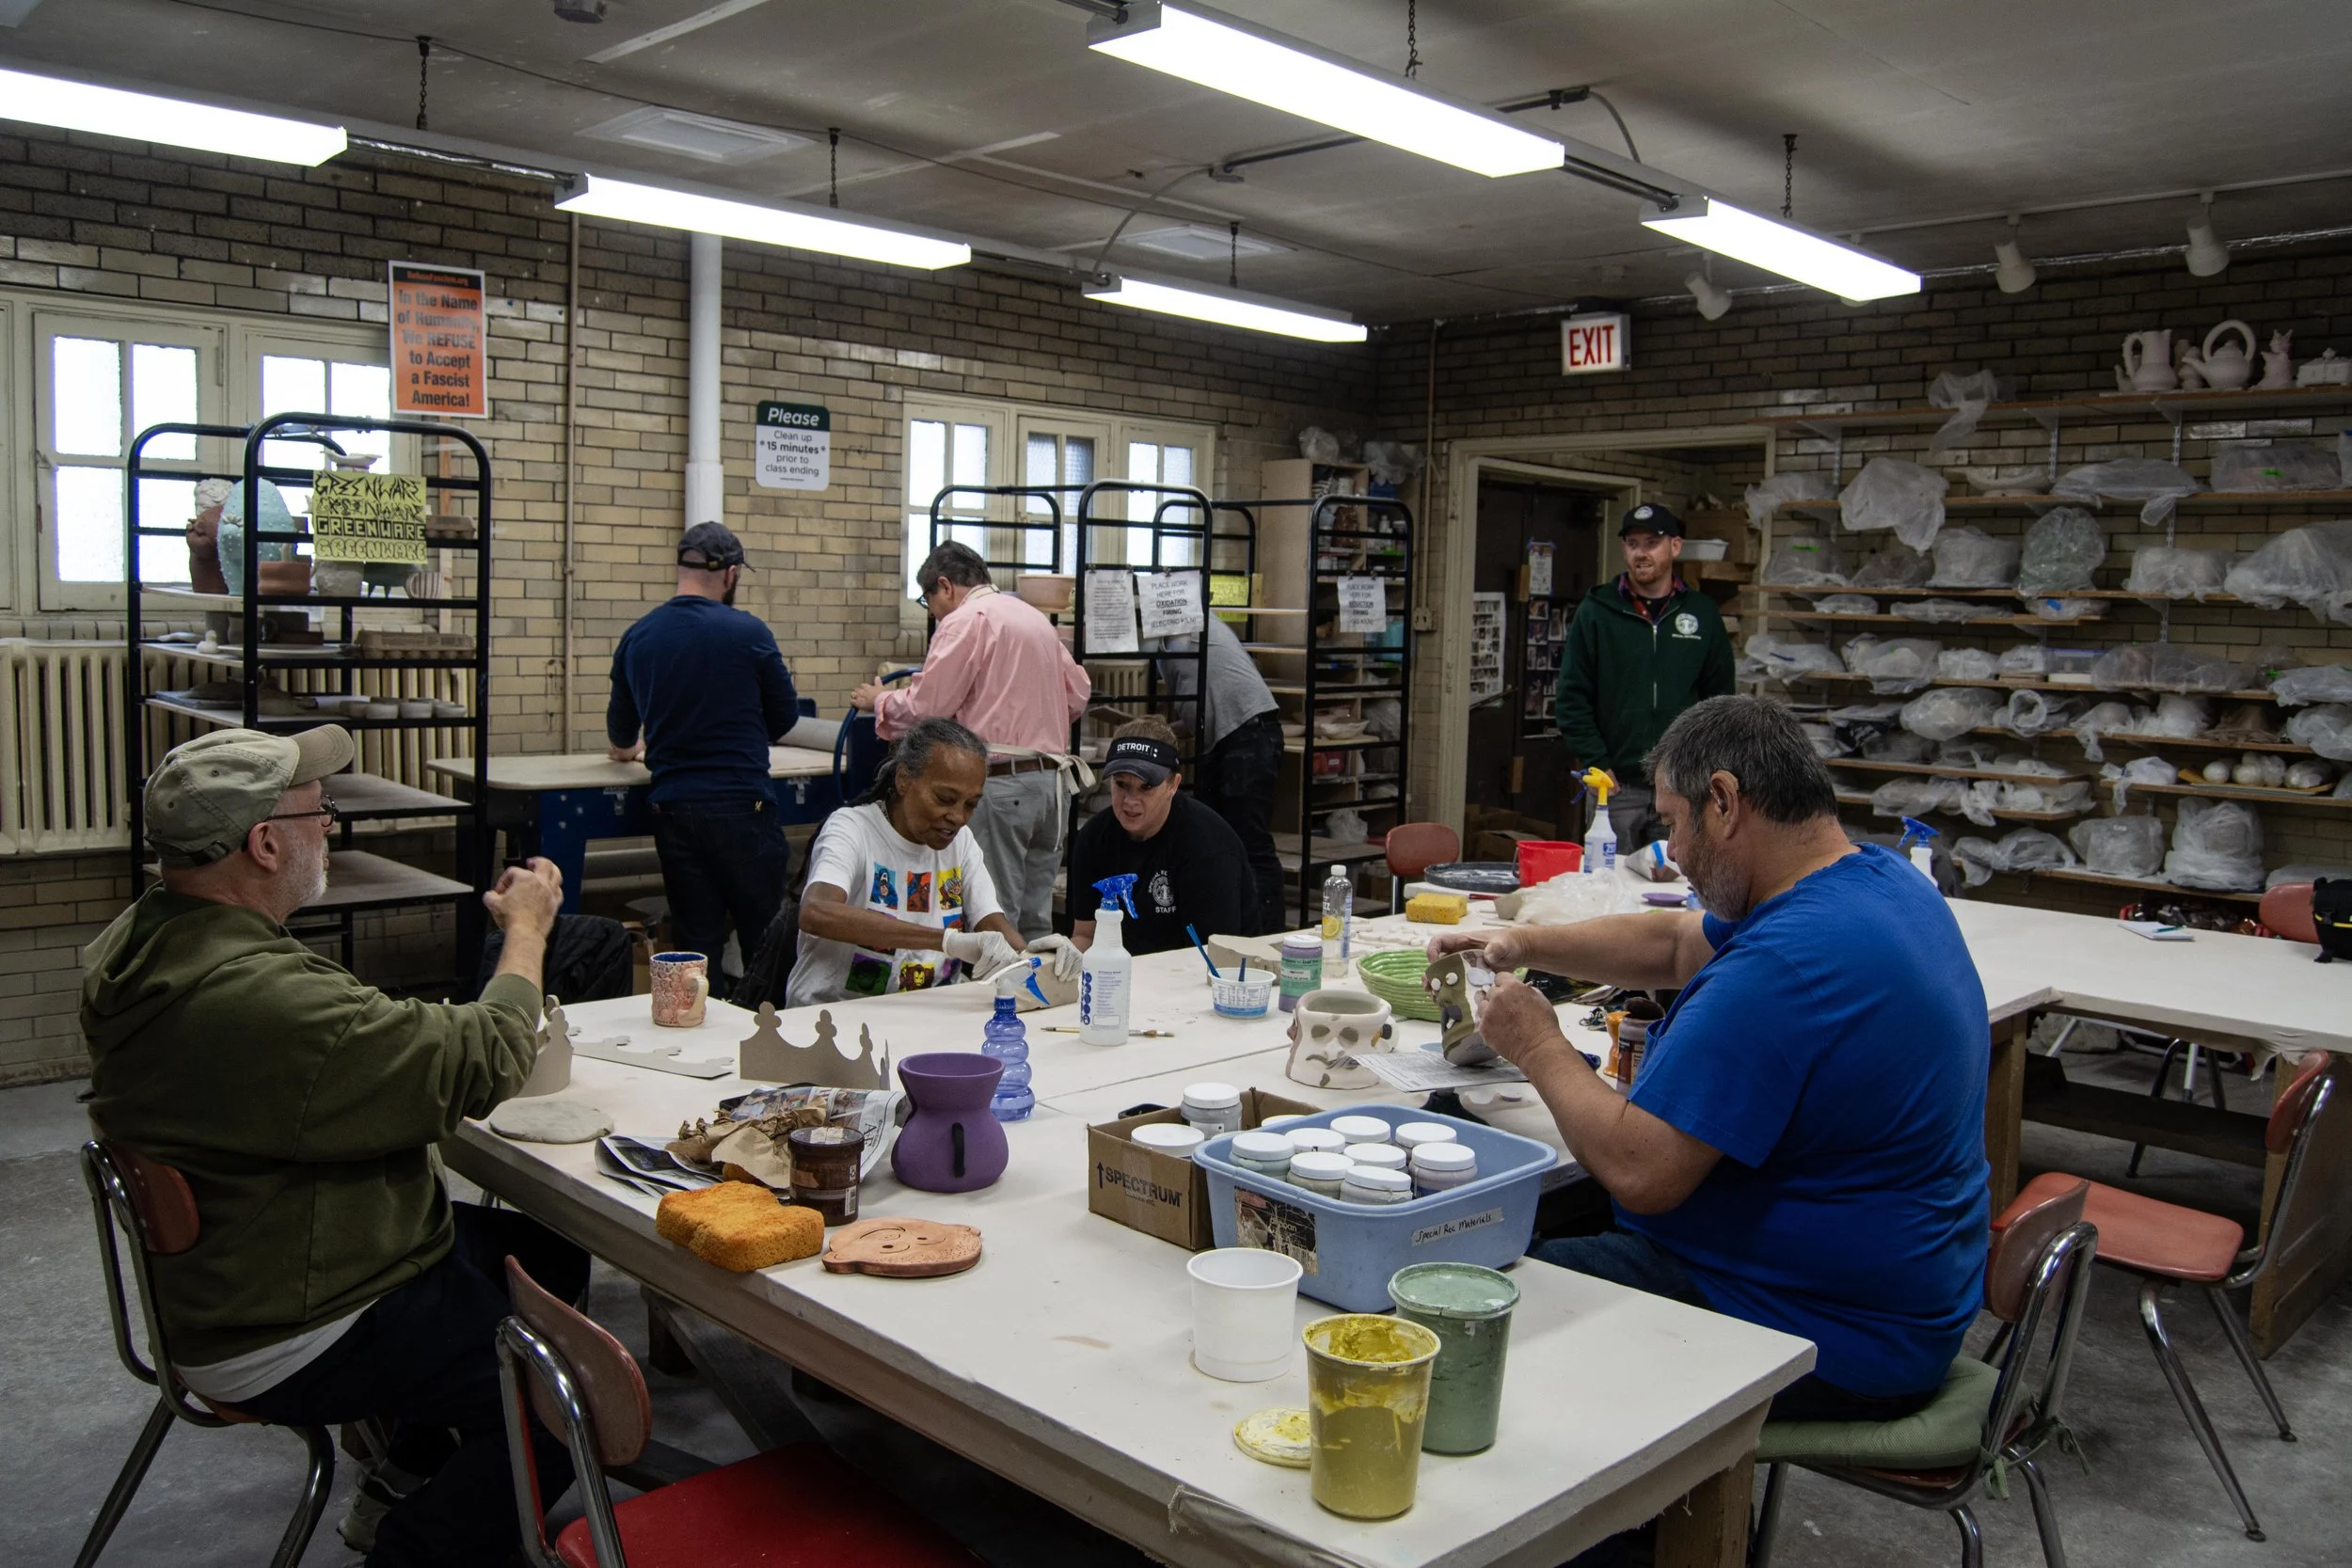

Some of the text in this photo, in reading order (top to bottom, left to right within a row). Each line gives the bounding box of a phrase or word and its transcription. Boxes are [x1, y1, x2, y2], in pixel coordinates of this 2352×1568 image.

[399, 290, 478, 311] In the Name
[397, 310, 410, 325] of
[402, 329, 476, 349] We REFUSE
[1568, 325, 1615, 367] EXIT
[409, 351, 470, 371] to Accept
[411, 371, 470, 388] a Fascist
[412, 389, 470, 407] America!
[768, 407, 819, 426] Please
[773, 430, 812, 442] Clean up
[767, 441, 819, 454] 15 minutes
[776, 454, 798, 463] prior
[765, 464, 819, 477] class ending
[315, 471, 421, 502] GREENWARE
[316, 515, 426, 541] GREENWARE
[315, 537, 426, 562] GREENWARE
[1170, 579, 1188, 588] WORK
[1155, 599, 1188, 608] OXIDATION
[1117, 742, 1151, 752] DETROIT
[1154, 905, 1178, 913] STAFF
[1105, 1166, 1182, 1208] SPECTRUM
[1415, 1212, 1491, 1243] Special Rec Materials
